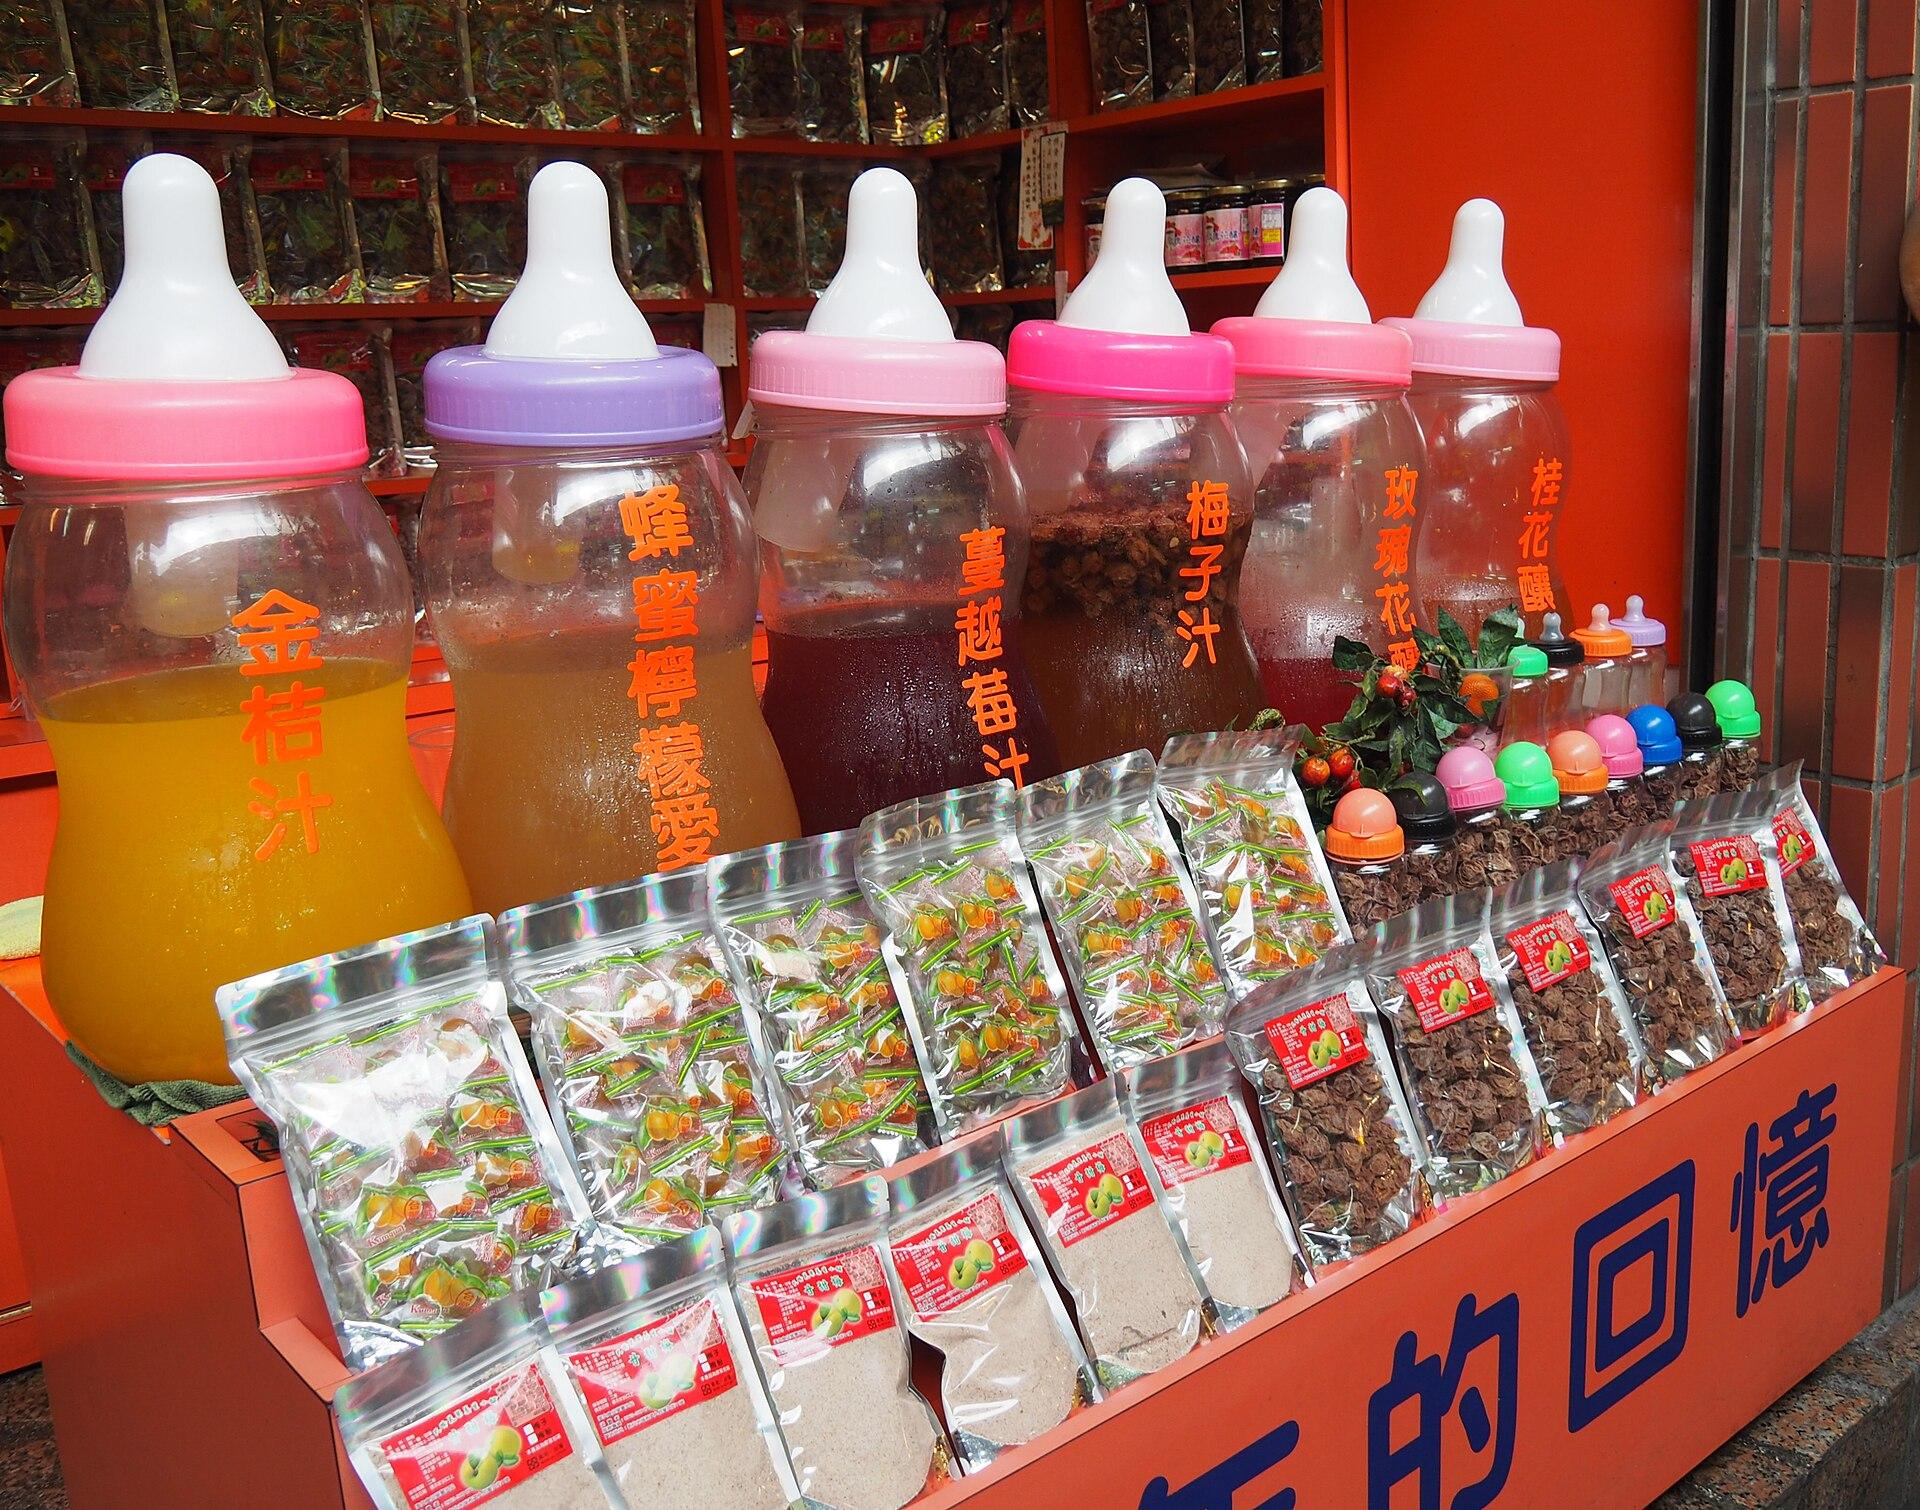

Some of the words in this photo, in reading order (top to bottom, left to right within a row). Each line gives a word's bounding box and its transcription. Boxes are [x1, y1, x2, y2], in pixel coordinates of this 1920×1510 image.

[954, 526, 1031, 790] 蔓越莓汁
[1176, 480, 1231, 668] 梅子汁
[1517, 457, 1563, 613] 桂花釀
[231, 588, 333, 862] 金桔汁
[618, 484, 721, 873] 蜂蜜檸檬愛
